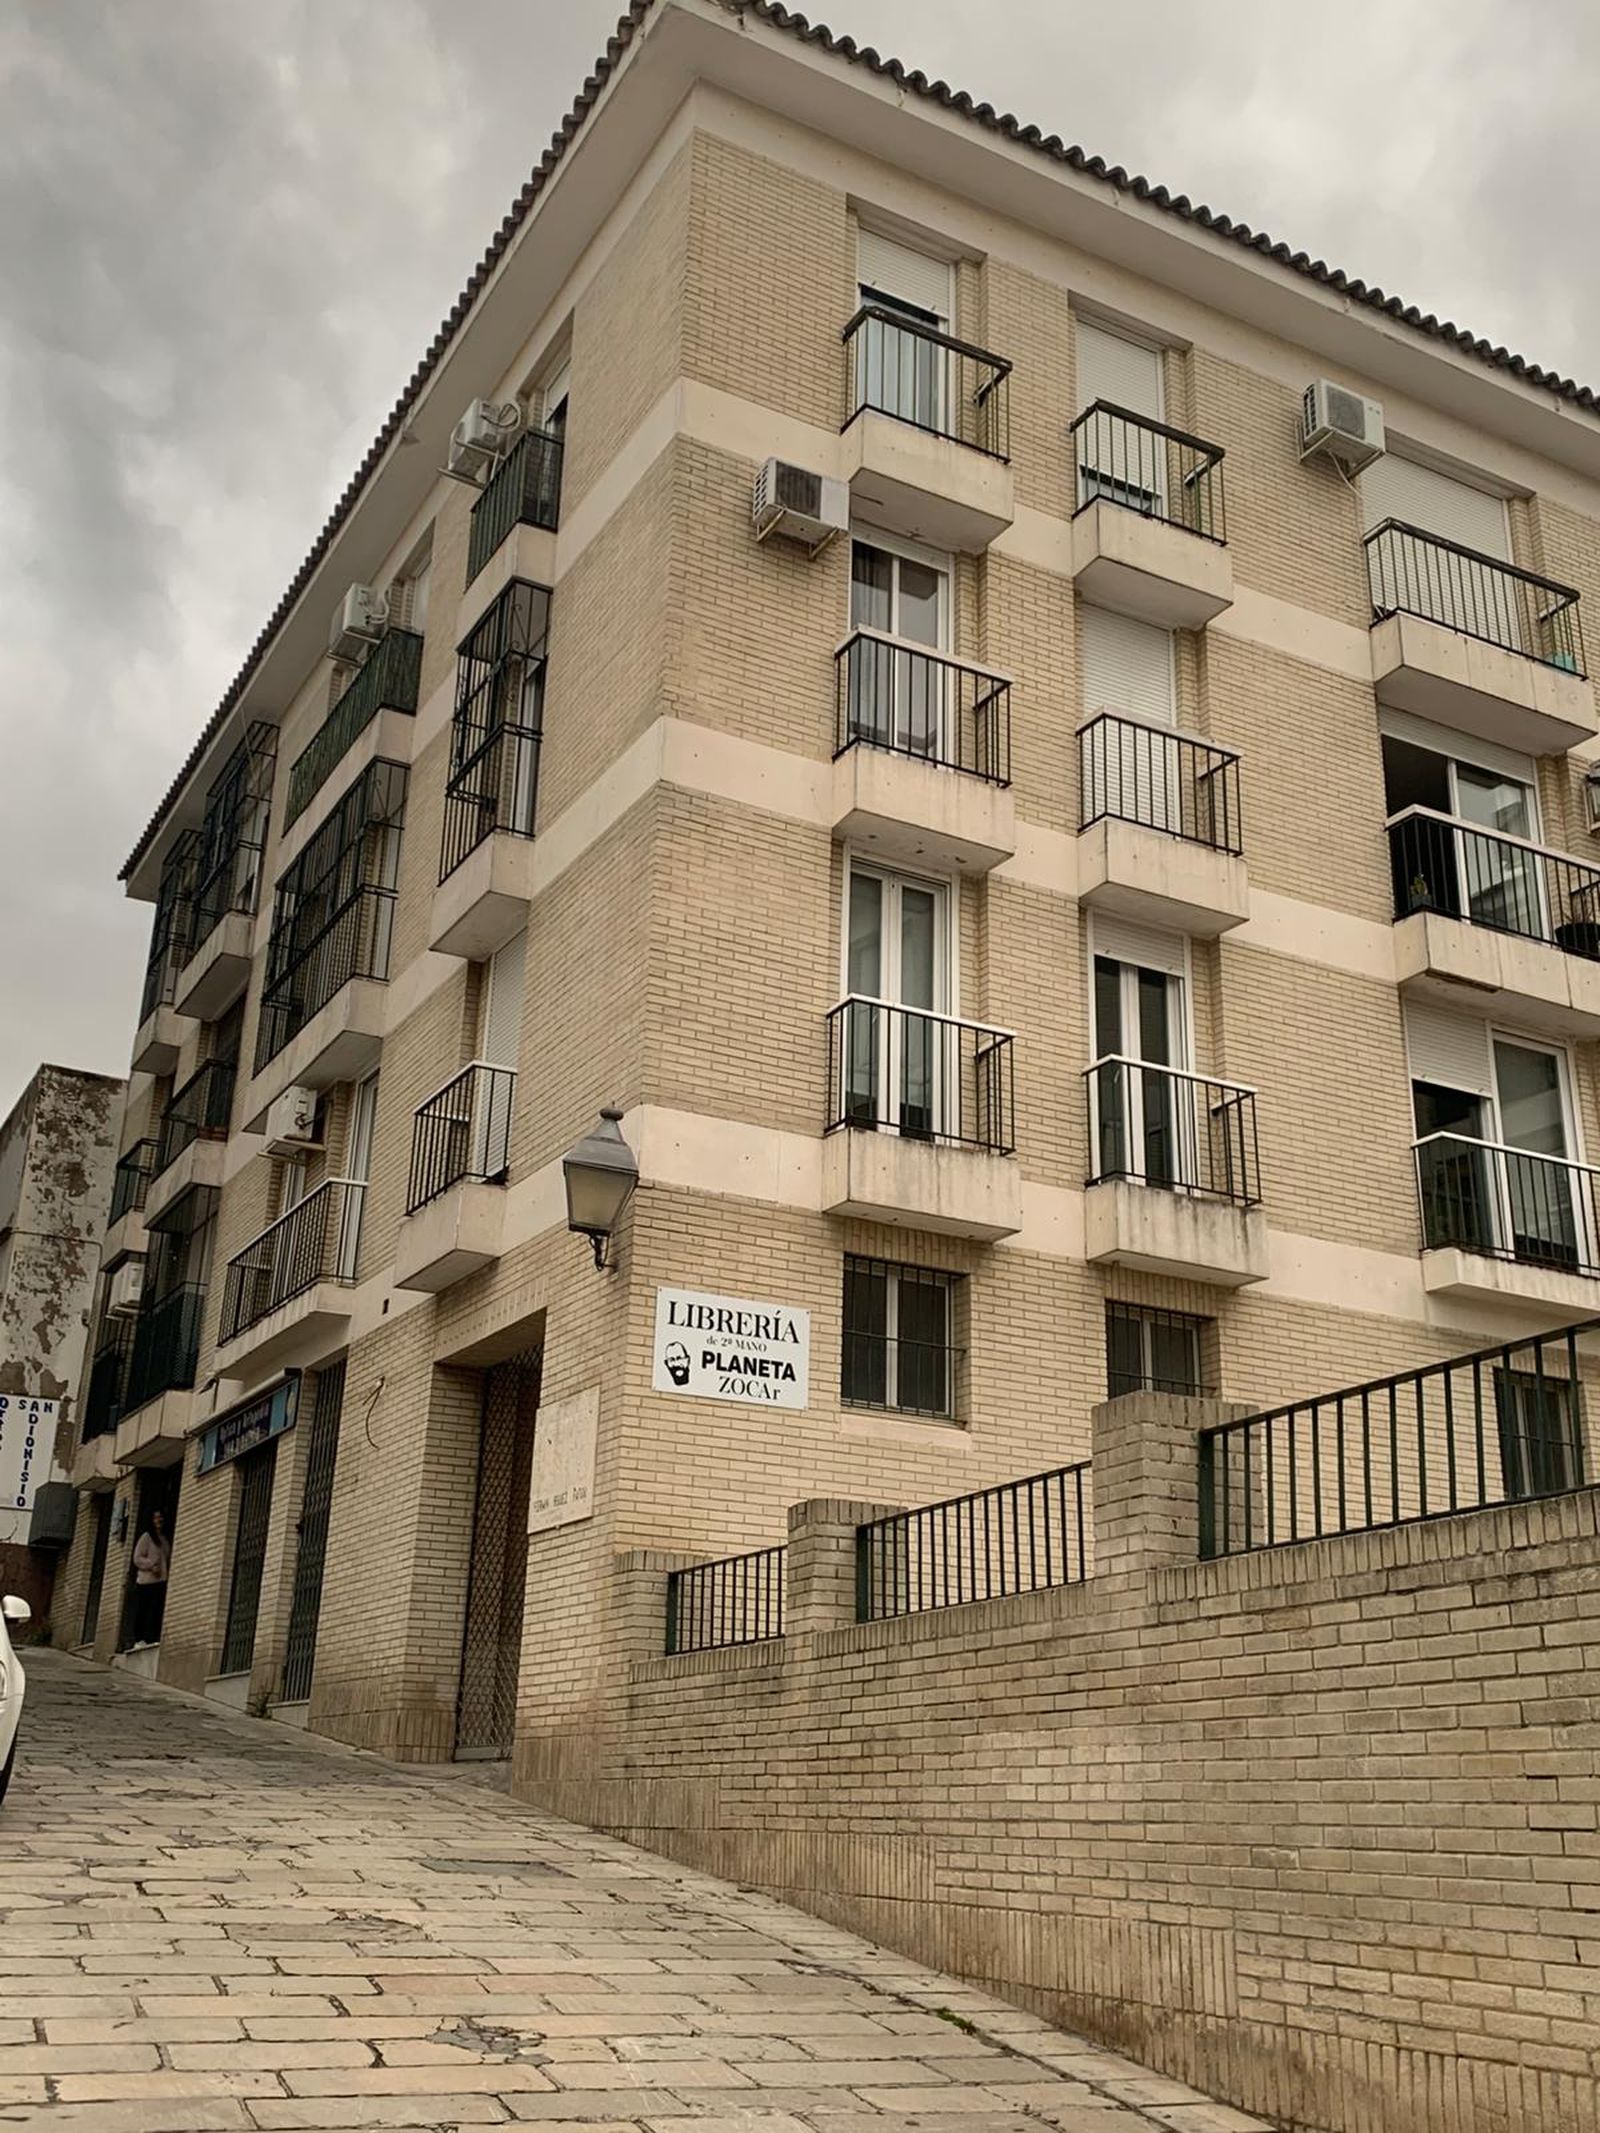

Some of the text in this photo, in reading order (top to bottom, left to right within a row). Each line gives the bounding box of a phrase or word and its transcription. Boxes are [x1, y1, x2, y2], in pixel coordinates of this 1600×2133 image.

[667, 1300, 800, 1344] LIBRERÍA
[706, 1335, 717, 1345] de
[735, 1339, 768, 1353] MANO
[702, 1350, 797, 1382] PLANETA
[18, 1399, 53, 1413] SAN
[16, 1413, 39, 1508] DIONISIO
